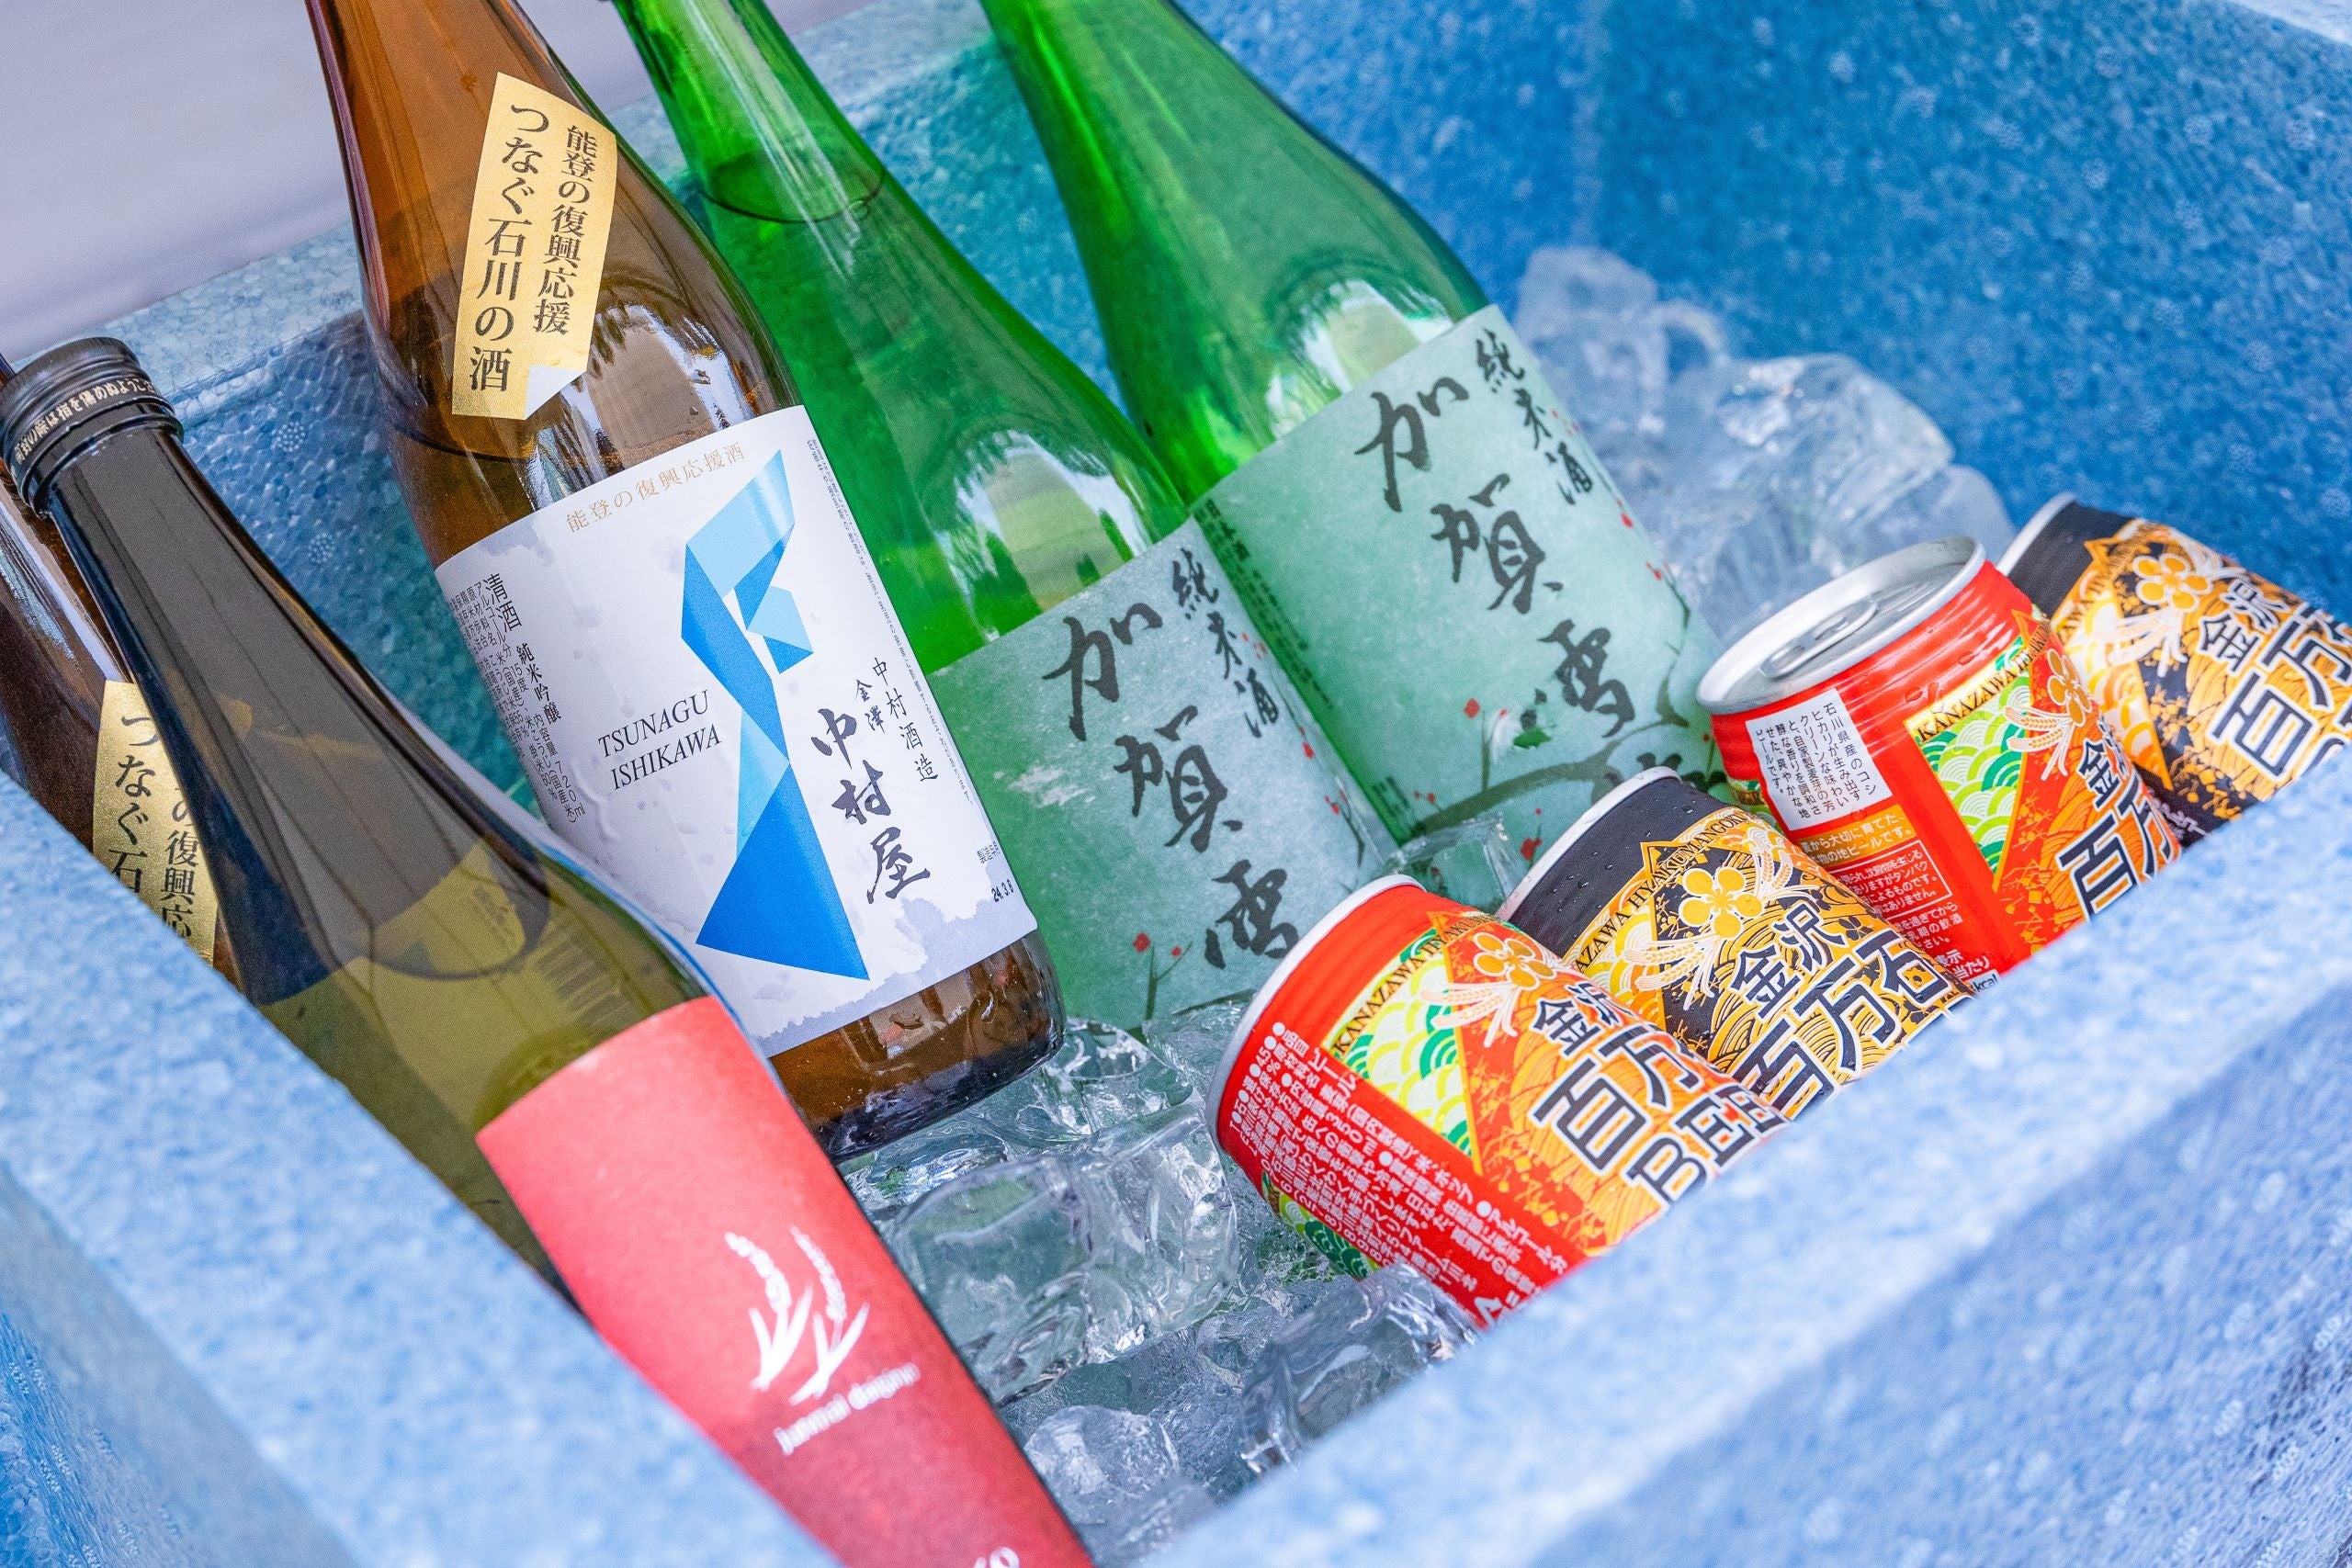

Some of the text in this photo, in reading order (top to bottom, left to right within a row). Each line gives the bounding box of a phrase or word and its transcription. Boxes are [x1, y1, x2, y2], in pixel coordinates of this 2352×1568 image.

[469, 103, 549, 392] つなぐ石川の酒
[533, 124, 598, 336] 能登の復興応援
[1476, 329, 1592, 505] 純米酒
[565, 442, 745, 534] 能登の復興応援酒
[1354, 377, 1637, 740] 加賀雪
[466, 588, 497, 648] 原材料名
[473, 581, 512, 658] アルコール分
[510, 662, 529, 693] 15度
[482, 572, 522, 633] 清酒
[515, 642, 561, 725] 純米吟醸
[1171, 548, 1279, 738] 純米酒
[2196, 579, 2290, 677] 金沢
[598, 689, 710, 759] TSUNAGU
[871, 656, 940, 782] 中村酒造
[1823, 703, 1876, 795] 石川県産のコシ
[1917, 669, 2018, 742] KANAZAWA
[610, 725, 723, 792] ISHIKAWA
[1756, 729, 1784, 794] ビールです。
[1766, 728, 1811, 819] せた、爽やかな地
[1800, 715, 1849, 807] クリーンな味わい
[1812, 710, 1860, 801] ヒカリが生み出す
[810, 708, 931, 904] 中村屋
[1332, 955, 1424, 1055] KANAZAWA
[1727, 902, 1849, 1023] 金沢
[1971, 974, 1998, 993] kcal
[1282, 1030, 1358, 1098] 品目 ビール
[1531, 981, 1634, 1059] 金沢
[1732, 930, 1952, 1121] 百万石
[1272, 1043, 1320, 1089] 原材料名
[1487, 1208, 1568, 1274] アルコール分
